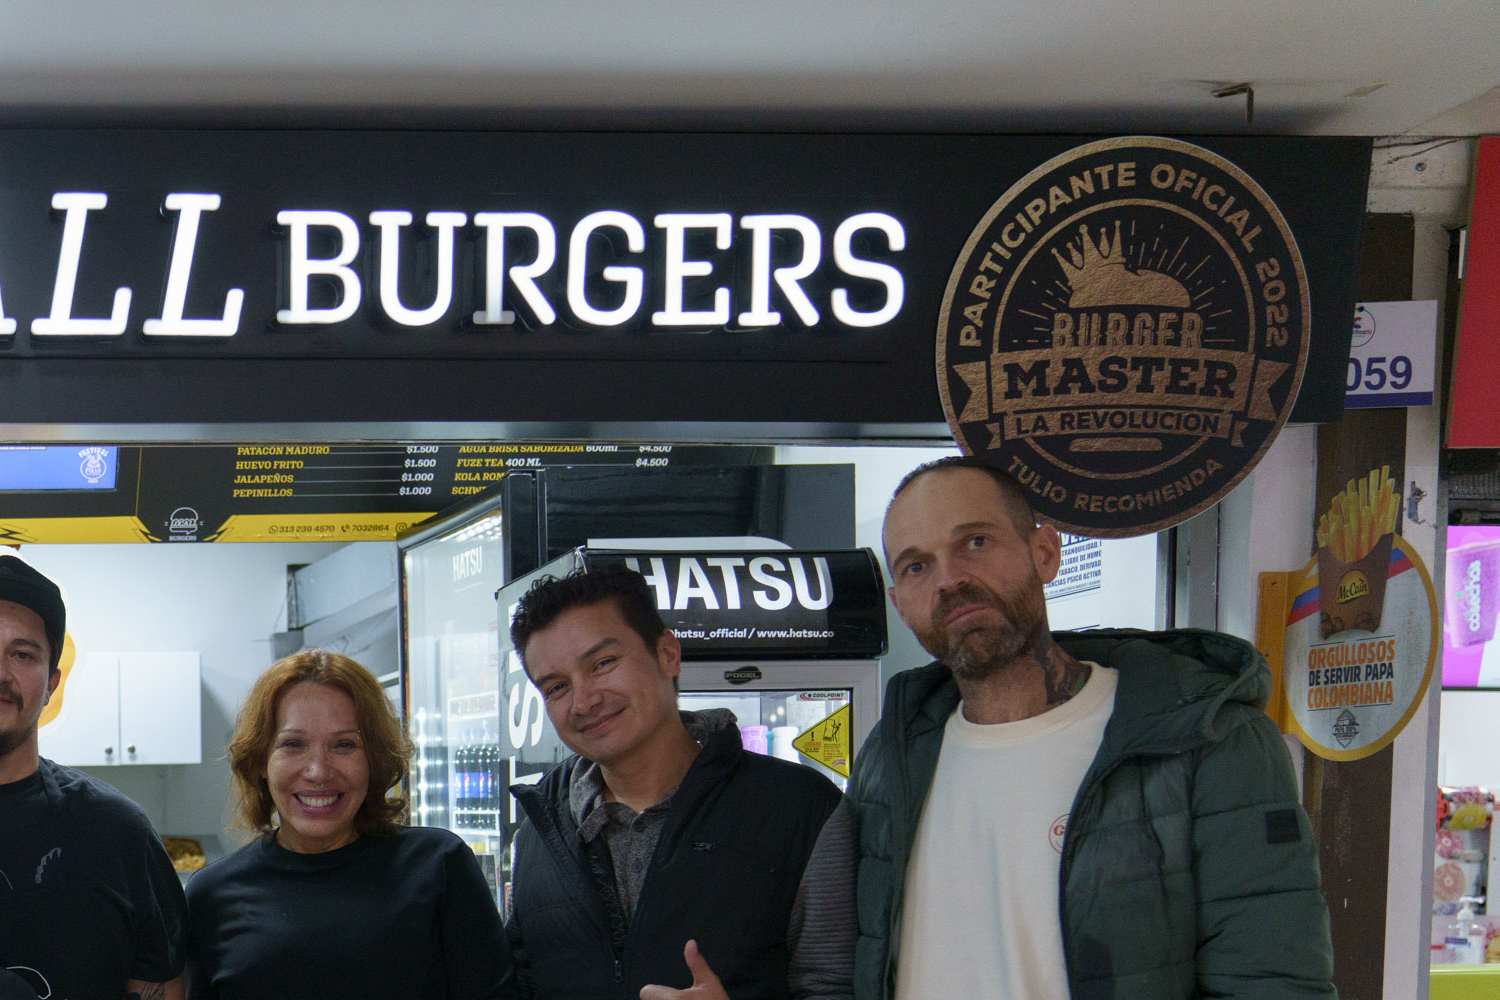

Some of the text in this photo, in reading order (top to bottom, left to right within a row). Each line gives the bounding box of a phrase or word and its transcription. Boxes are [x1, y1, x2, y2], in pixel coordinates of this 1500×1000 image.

[959, 161, 1290, 347] PARTICIPANTE OFICIAL 2022
[276, 210, 906, 327] BURGERS
[1051, 312, 1203, 350] BURGER
[1003, 355, 1239, 400] MASTER
[1015, 412, 1049, 435] LA
[284, 446, 330, 455] MADURO
[456, 458, 668, 467] FUZE TEA 400 ML $4.500
[236, 458, 436, 470] HUEVO FRITO $1.500
[234, 472, 434, 484] JALAPEÑOS $1.000
[454, 473, 481, 481] KOLA
[1007, 455, 1224, 514] TULIO RECOMIENDA
[233, 486, 432, 498] PEPINILLOS $1.000
[452, 547, 483, 582] HATSU
[1338, 578, 1367, 600] McCain
[670, 627, 835, 641] hatsu_official www.hatsu.co
[1309, 640, 1396, 669] ORGULLOSOS
[1309, 662, 1394, 687] DE SERVIR PAPA
[1307, 681, 1394, 709] COLOMBIANA
